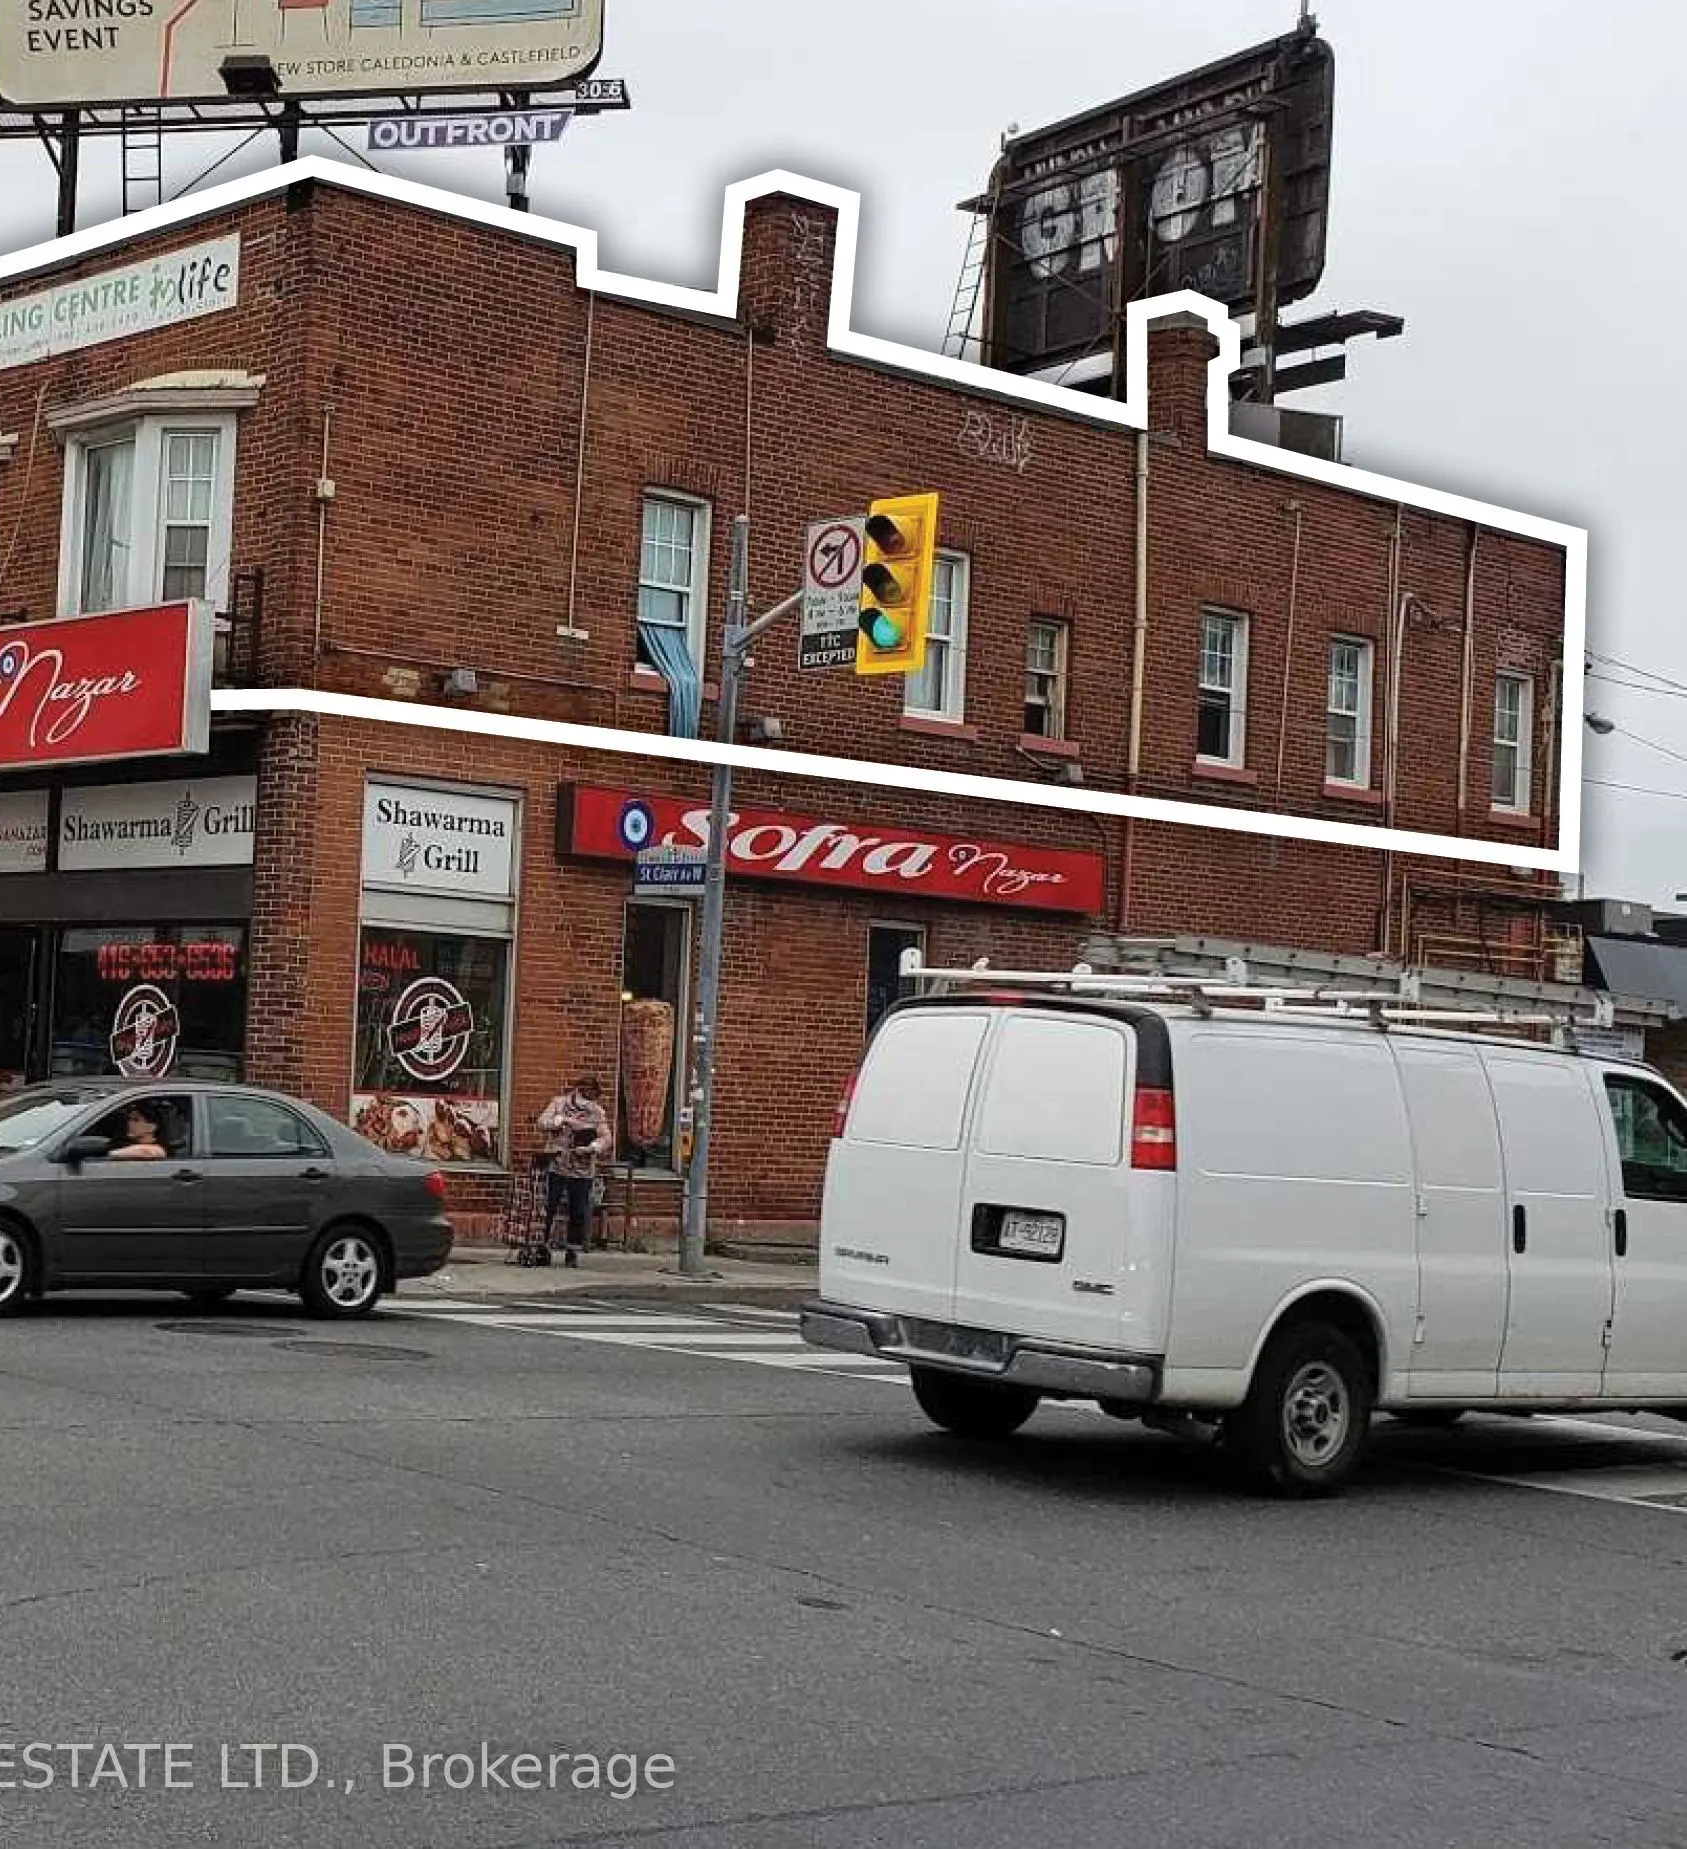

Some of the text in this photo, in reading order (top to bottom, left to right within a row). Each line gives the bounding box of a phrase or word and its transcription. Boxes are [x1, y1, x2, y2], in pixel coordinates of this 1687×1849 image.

[28, 0, 153, 21] SAVINGS
[27, 27, 120, 52] EVENT
[276, 46, 581, 77] EW STORE CALEDONIA & CASTLEFIELD
[373, 113, 561, 148] OUTFRONT
[54, 274, 141, 322] CENTRE
[804, 648, 855, 666] EXCEPTED
[64, 804, 254, 842] Shawarma Grill
[377, 798, 504, 838] Shawarma
[424, 844, 478, 874] Grill
[662, 808, 1069, 894] Sofra Nazar
[364, 942, 421, 969] HALAL
